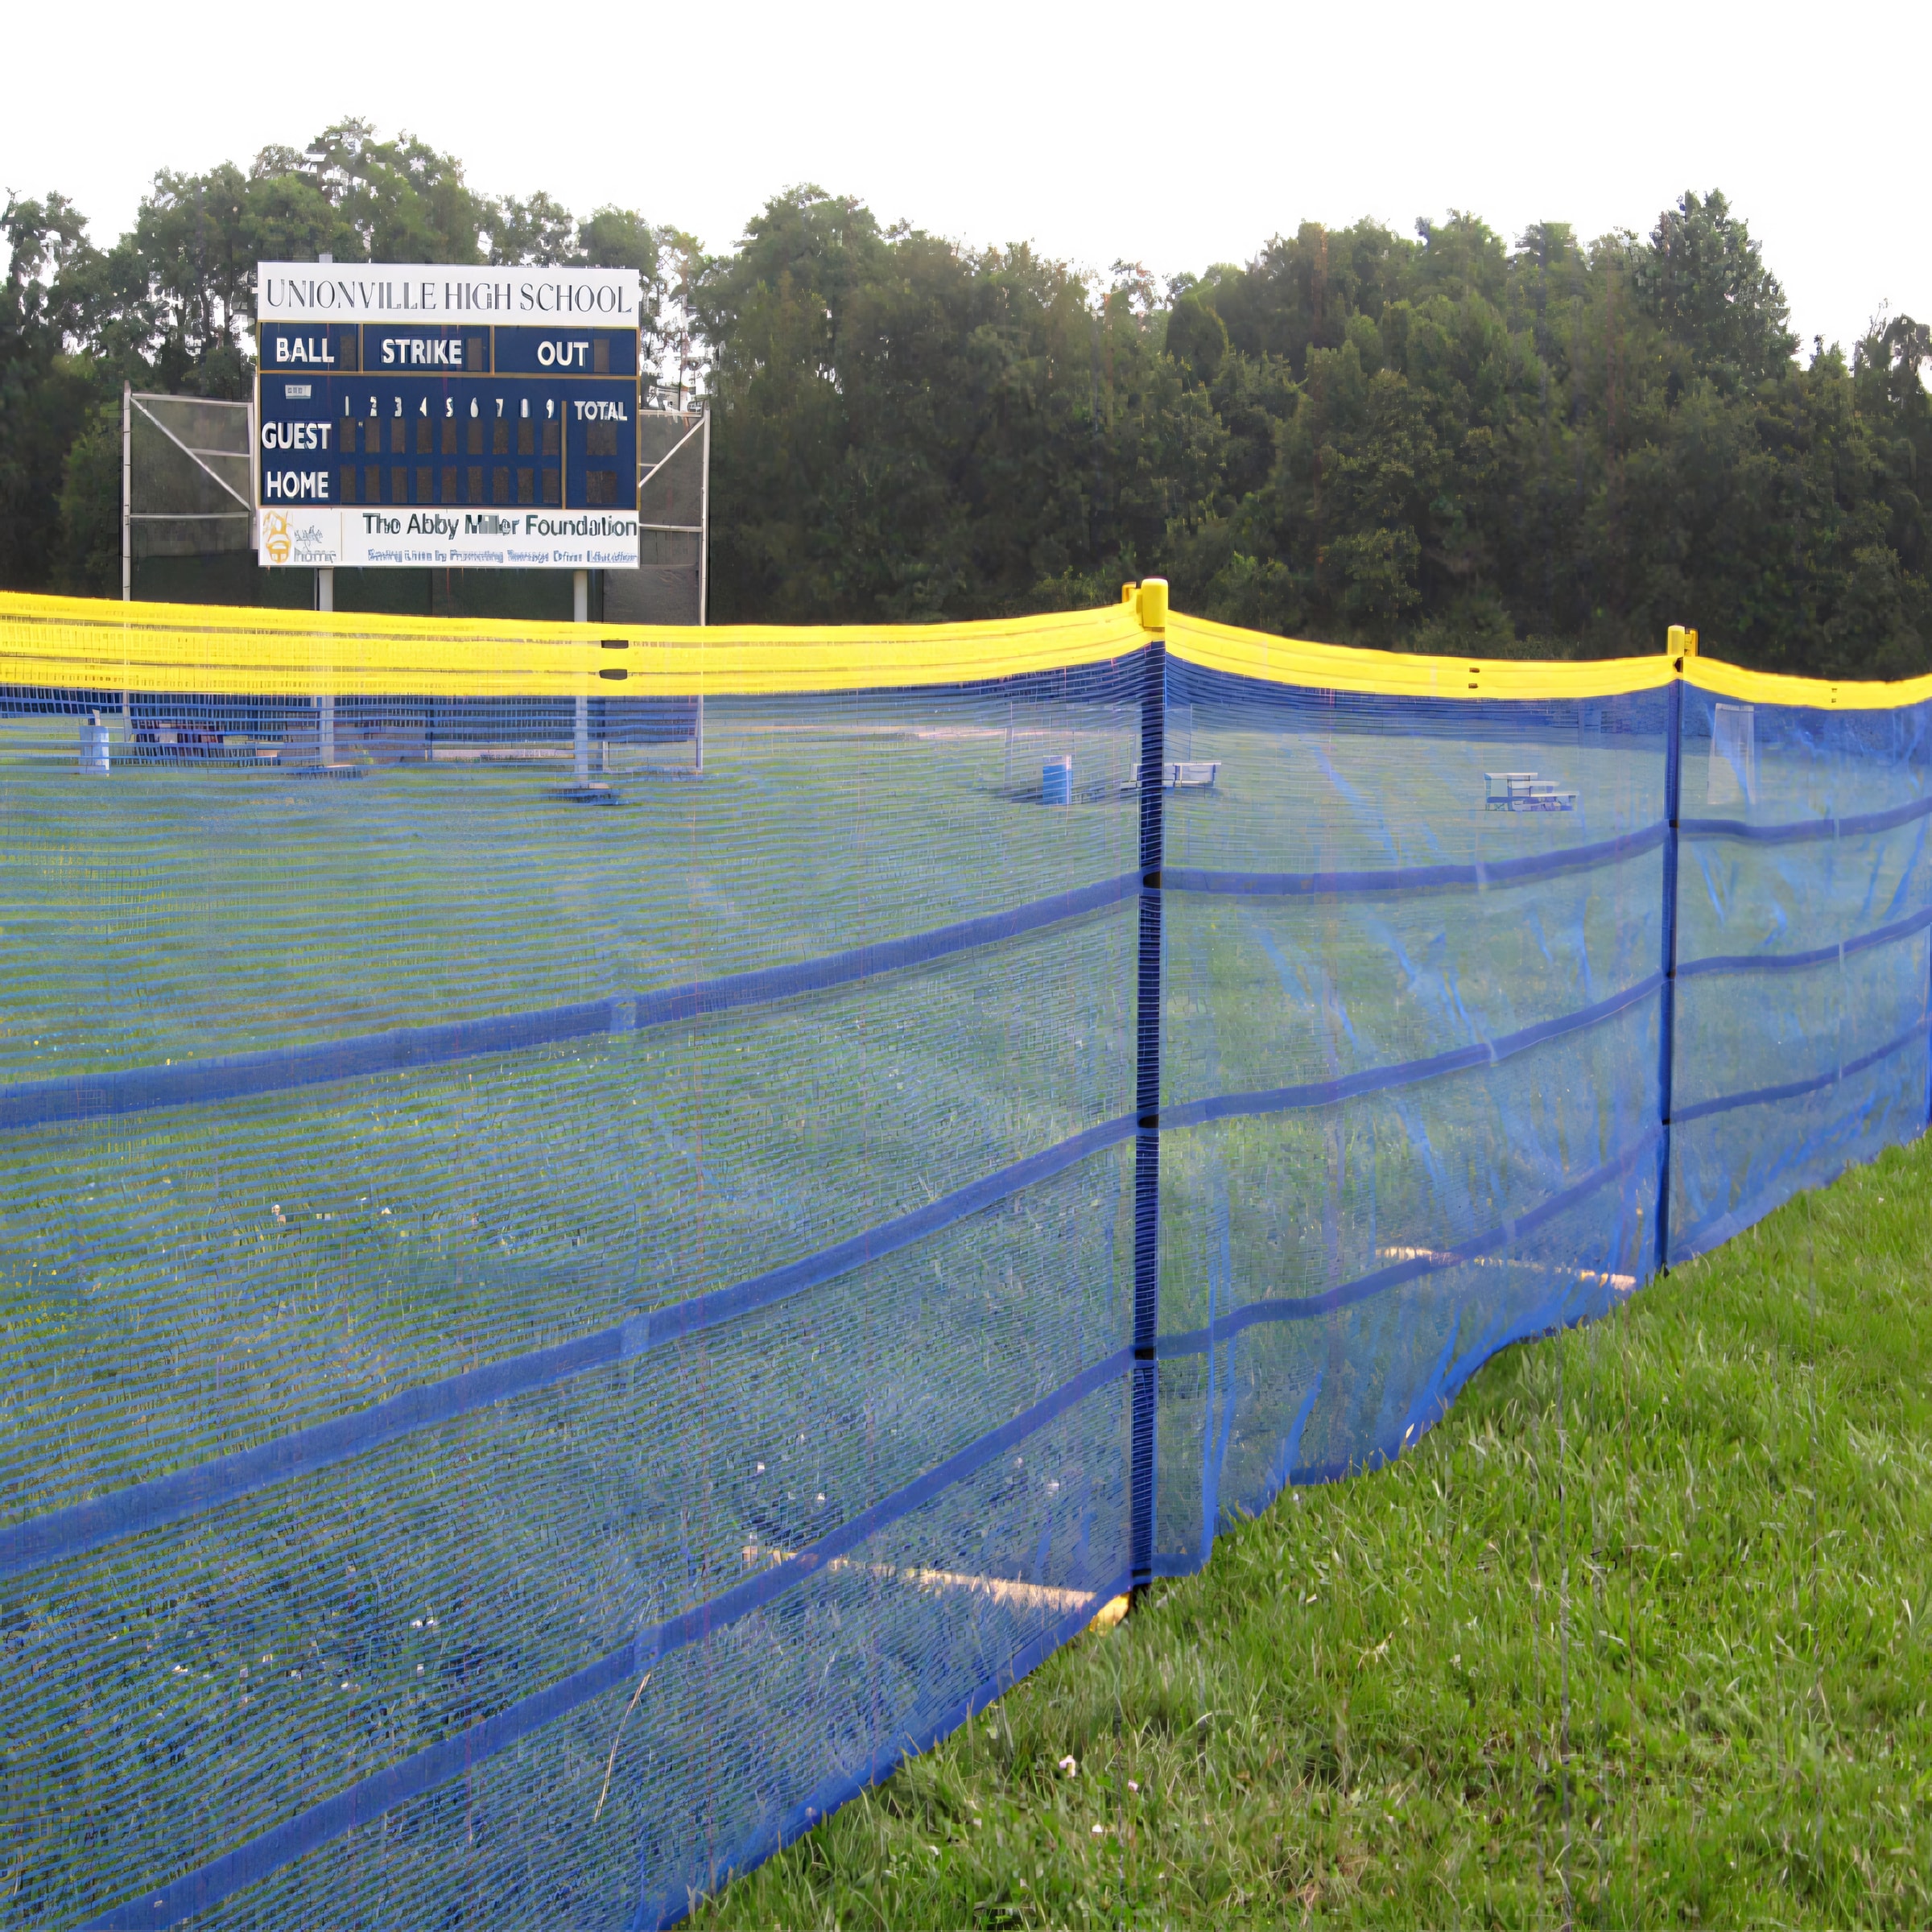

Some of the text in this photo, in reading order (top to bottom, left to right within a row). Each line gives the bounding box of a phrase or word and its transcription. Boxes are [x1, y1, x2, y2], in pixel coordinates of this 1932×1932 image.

[266, 278, 634, 313] UNIONVILLE HIGH SCHOOL
[276, 337, 335, 363] BALL
[382, 337, 463, 365] STRIKE
[537, 340, 590, 366] OUT
[369, 395, 378, 417] 2
[394, 396, 402, 417] 3
[419, 396, 427, 417] 4
[495, 398, 504, 418] 7
[546, 398, 555, 419] 9
[574, 400, 628, 421] TOTAL
[261, 421, 332, 450] GUEST
[266, 471, 329, 499] HOME
[362, 513, 401, 535] The
[407, 513, 460, 540] Abby
[526, 514, 638, 537] Foundation
